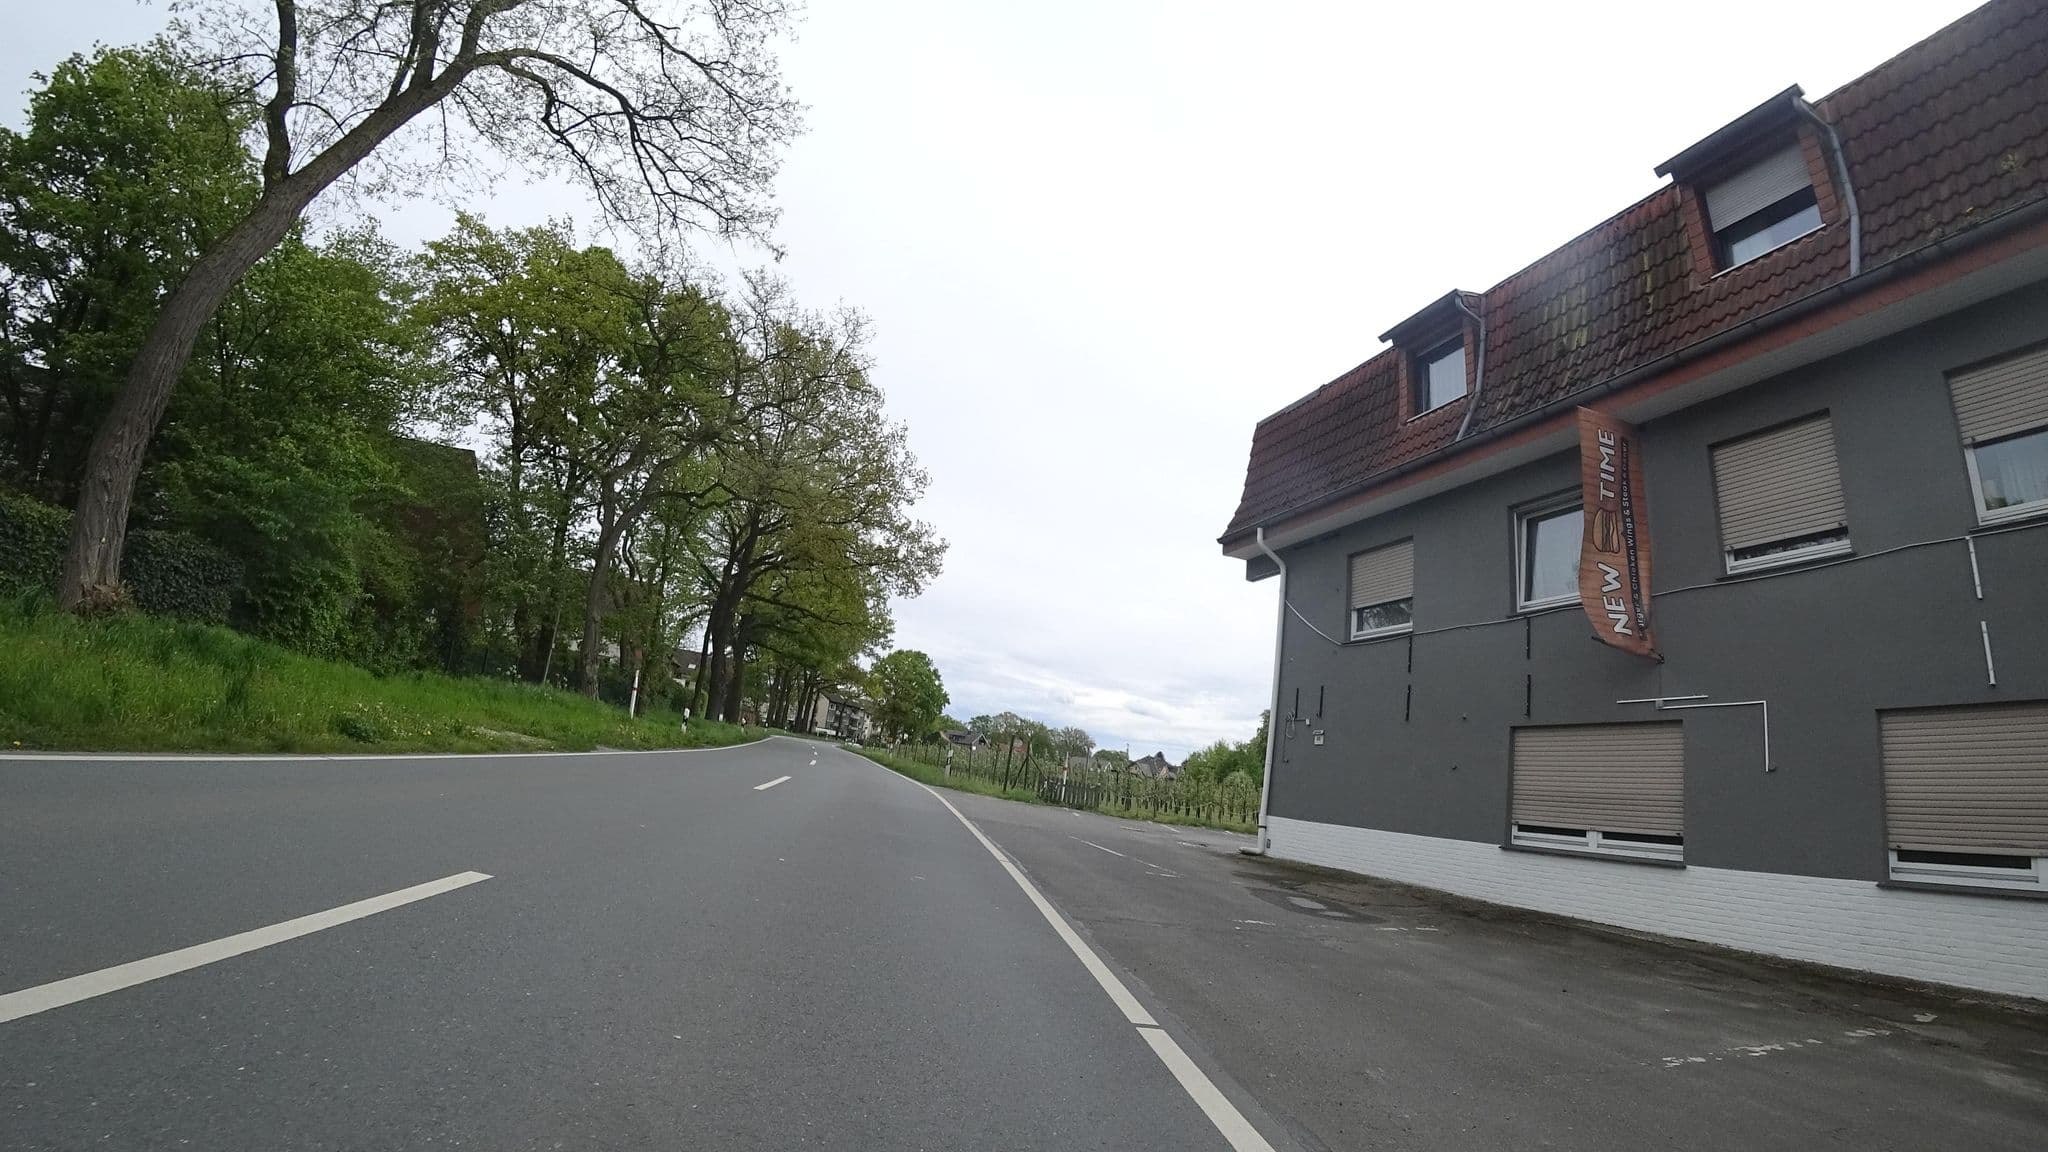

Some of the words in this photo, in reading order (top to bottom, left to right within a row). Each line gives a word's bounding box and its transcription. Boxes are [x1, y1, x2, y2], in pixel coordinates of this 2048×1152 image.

[1598, 428, 1615, 501] TIME
[1622, 481, 1630, 507] Steak
[1626, 518, 1635, 547] Wings
[1629, 549, 1639, 591] Chicken
[1597, 561, 1633, 636] NEW
